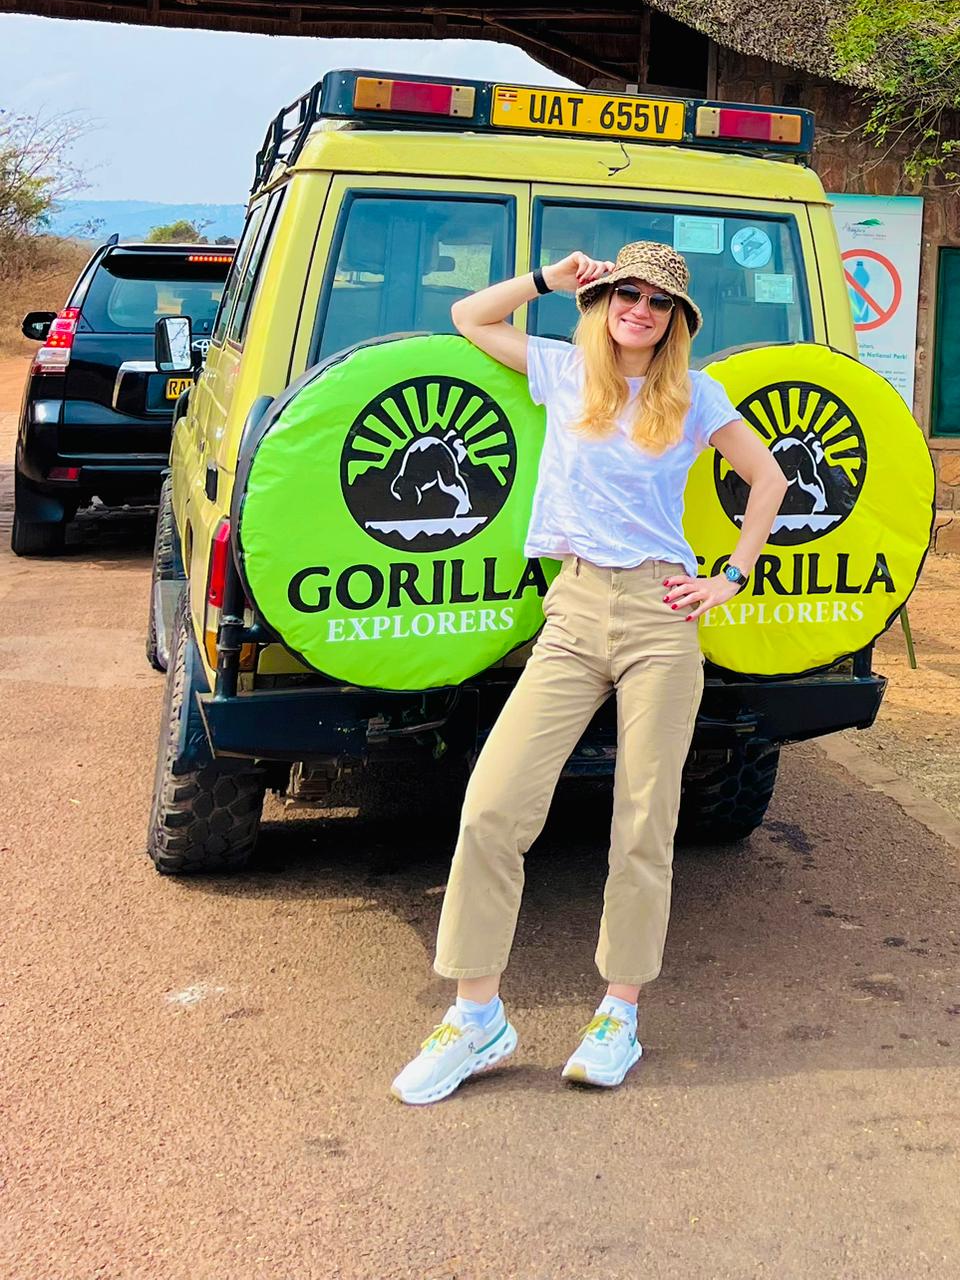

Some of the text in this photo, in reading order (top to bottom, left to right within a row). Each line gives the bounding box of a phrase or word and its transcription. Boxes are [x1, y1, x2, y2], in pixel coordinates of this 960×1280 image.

[529, 94, 670, 134] UAT 655V
[287, 557, 550, 613] GORILLA
[695, 552, 897, 597] RILLA
[325, 607, 515, 643] EXPLORERS
[702, 600, 864, 627] EXPLORERS
